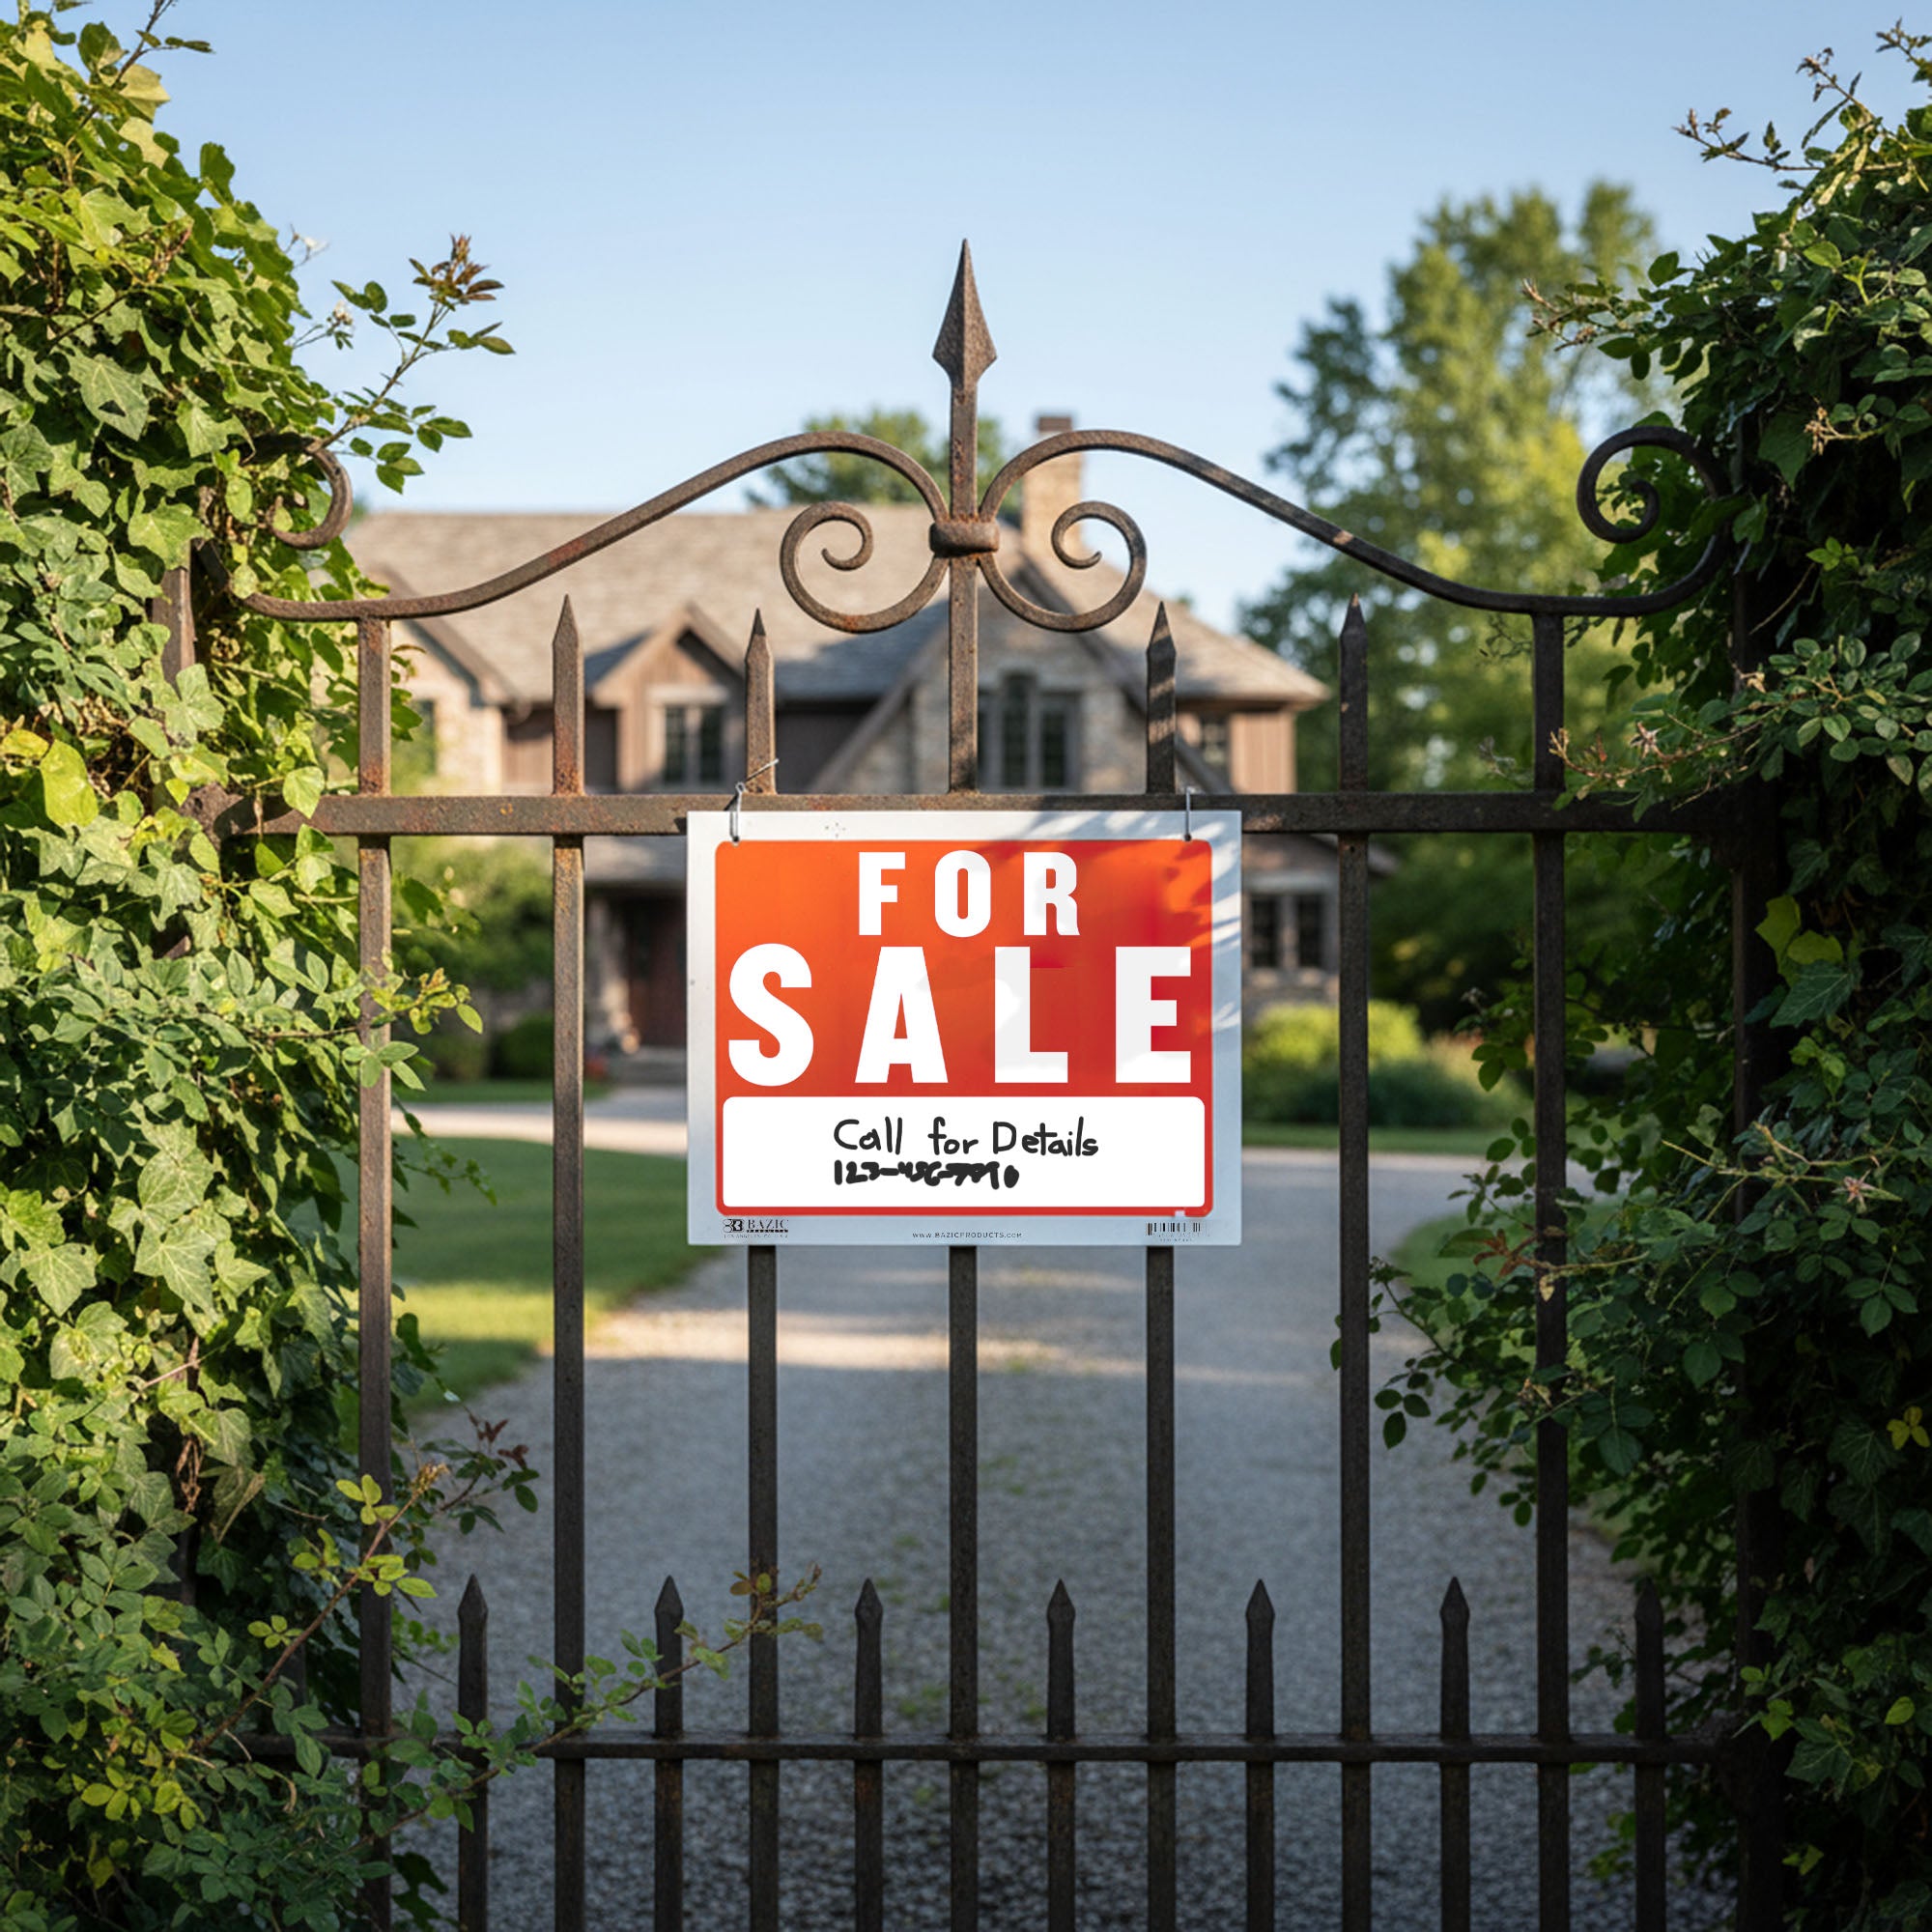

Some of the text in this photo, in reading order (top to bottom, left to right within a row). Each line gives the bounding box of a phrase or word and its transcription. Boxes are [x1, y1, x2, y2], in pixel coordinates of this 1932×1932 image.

[858, 849, 1081, 938] FOR
[727, 943, 1191, 1087] SALE
[833, 1116, 1099, 1157] Call for Details
[747, 1218, 789, 1230] BAZIC
